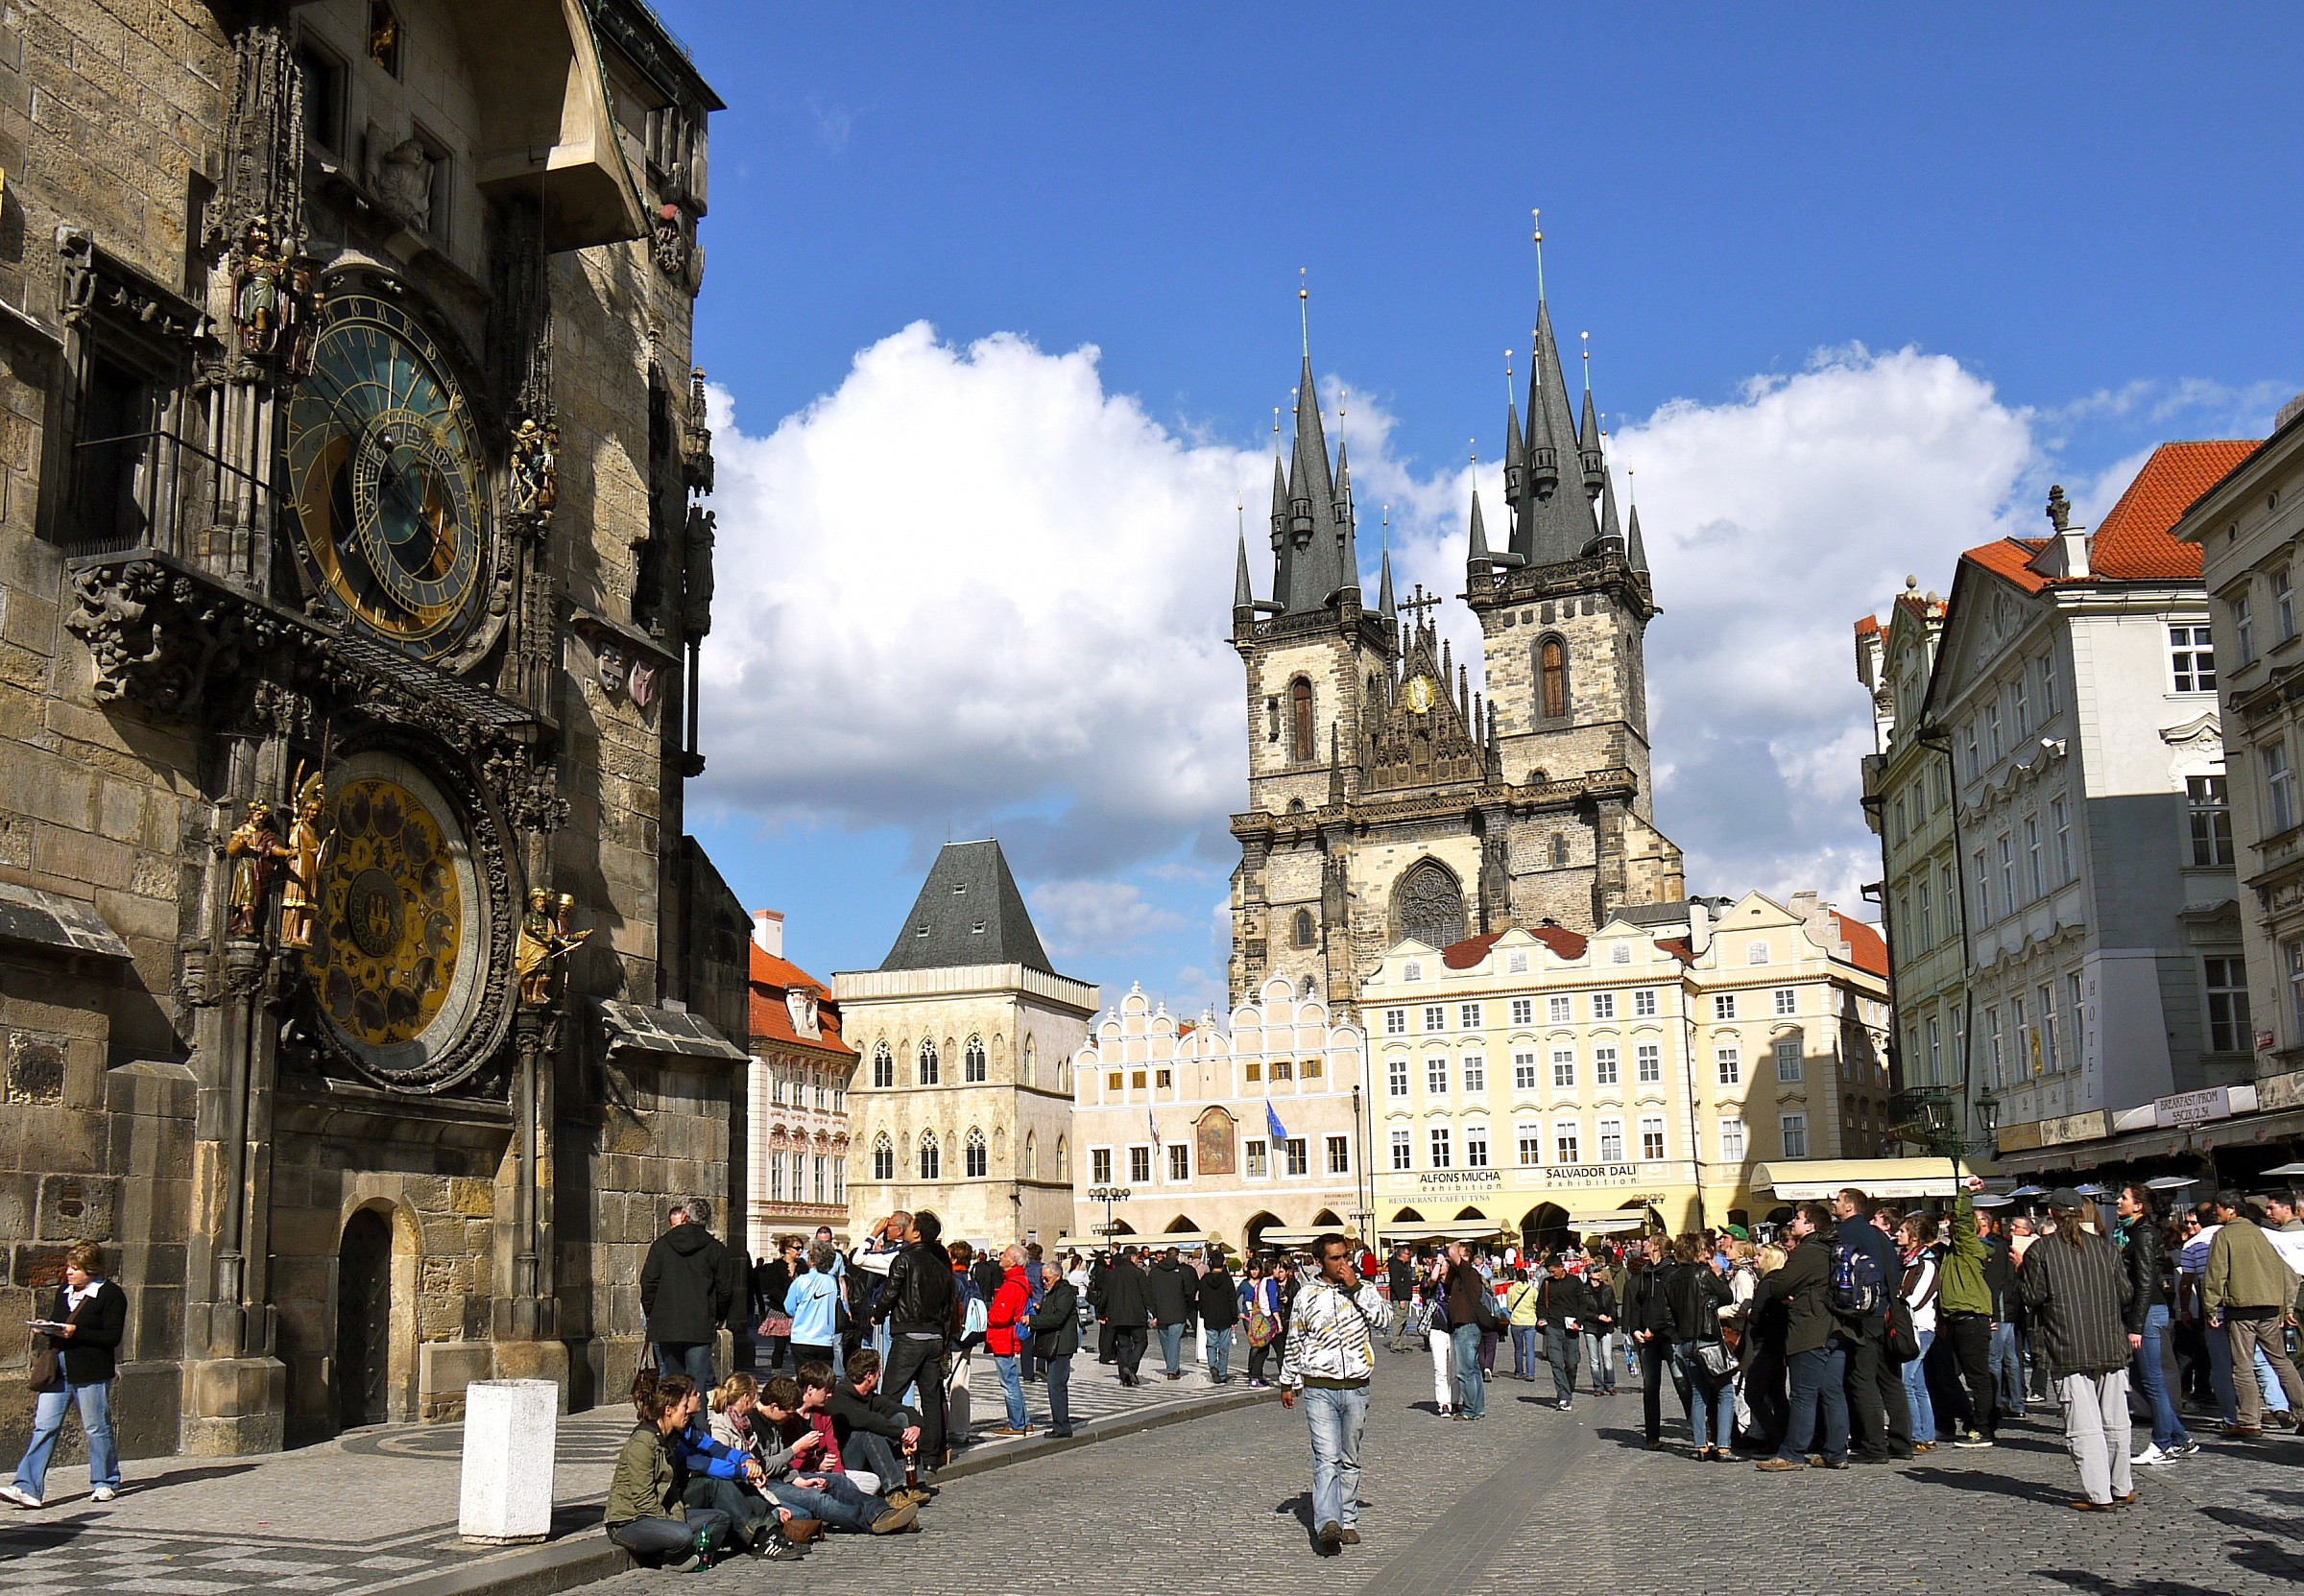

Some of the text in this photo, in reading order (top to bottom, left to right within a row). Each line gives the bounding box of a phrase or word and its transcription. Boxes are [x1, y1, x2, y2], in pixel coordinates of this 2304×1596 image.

[1420, 1171, 1501, 1183] ALFONS MUCHA
[1547, 1167, 1605, 1179] SALVADOR
[1422, 1182, 1501, 1192] exhibition
[1547, 1178, 1637, 1188] exhibition
[1388, 1196, 1438, 1204] RESTAURANT
